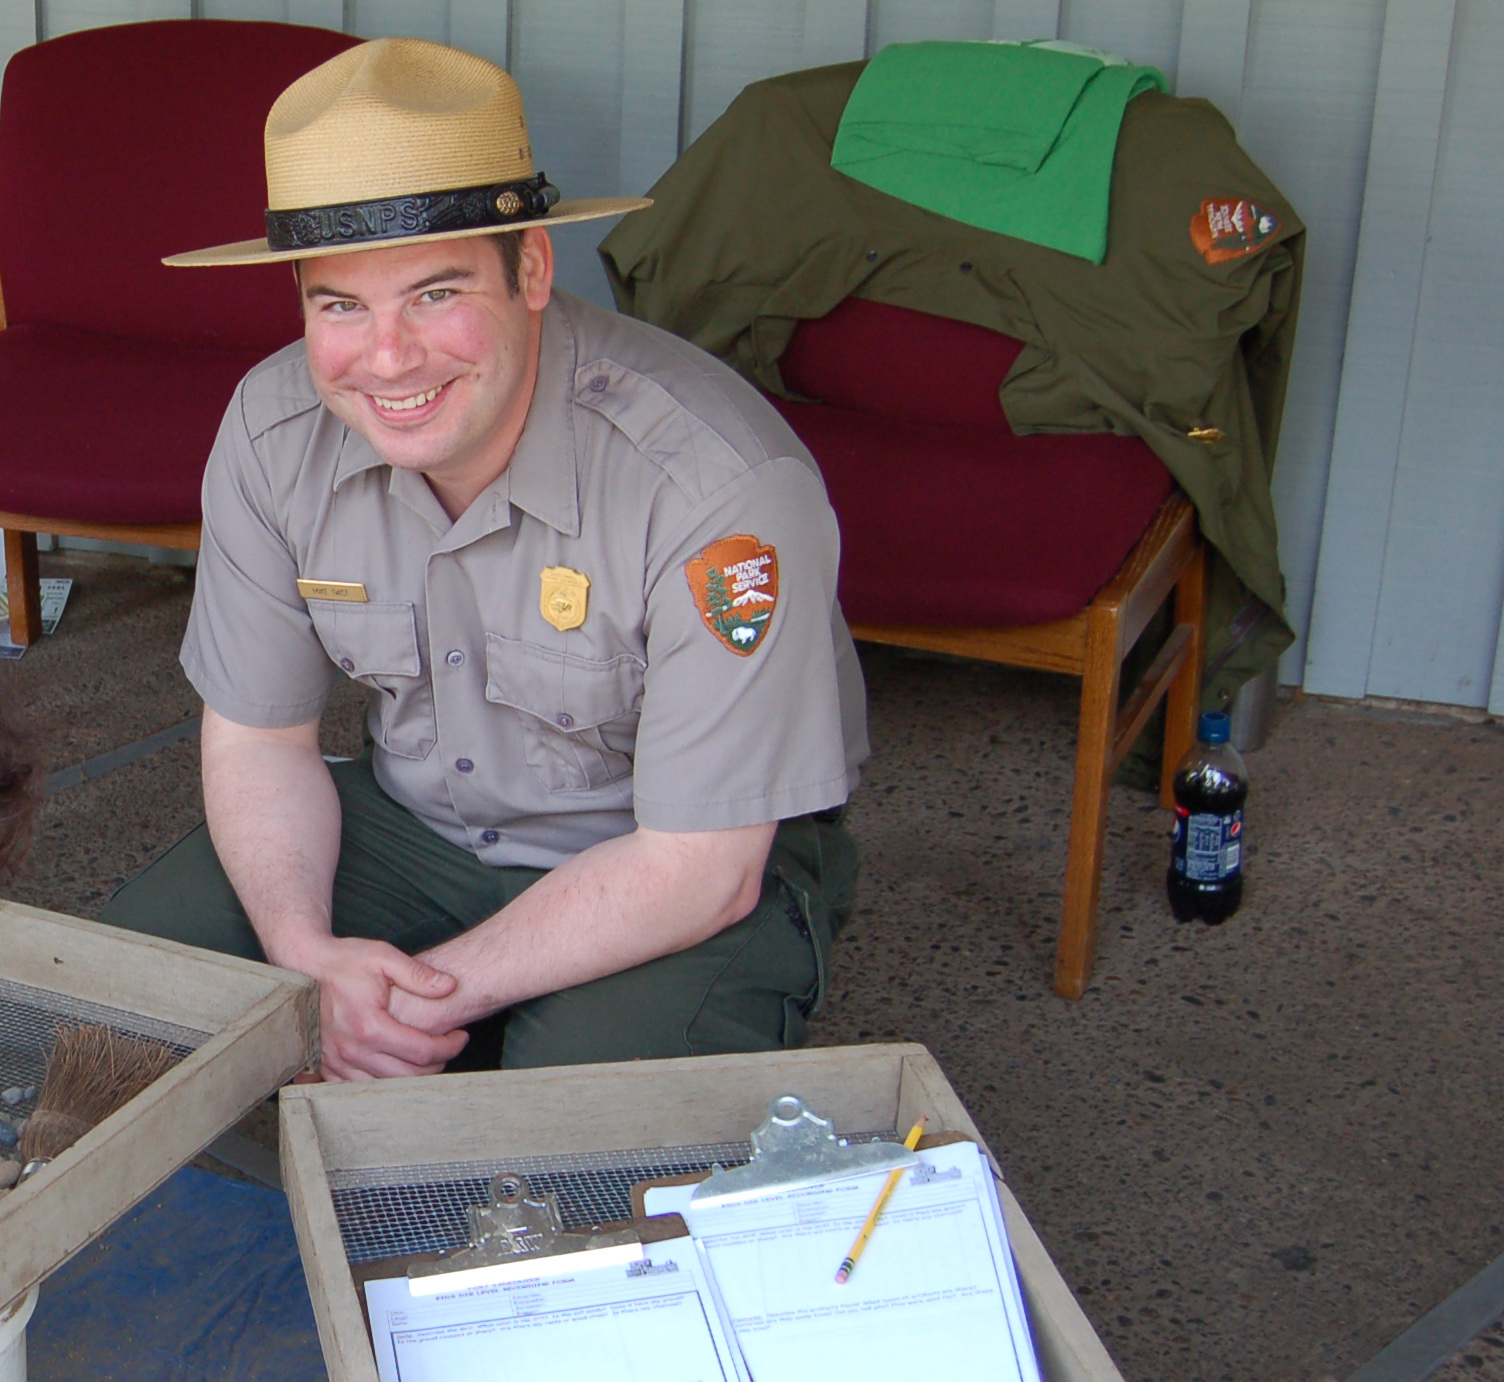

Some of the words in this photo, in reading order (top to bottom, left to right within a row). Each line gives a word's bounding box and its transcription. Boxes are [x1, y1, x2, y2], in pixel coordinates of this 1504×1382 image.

[318, 202, 421, 239] USNPS
[724, 554, 772, 577] NATIONAL
[736, 567, 761, 582] PARK
[732, 573, 769, 593] SERVICE
